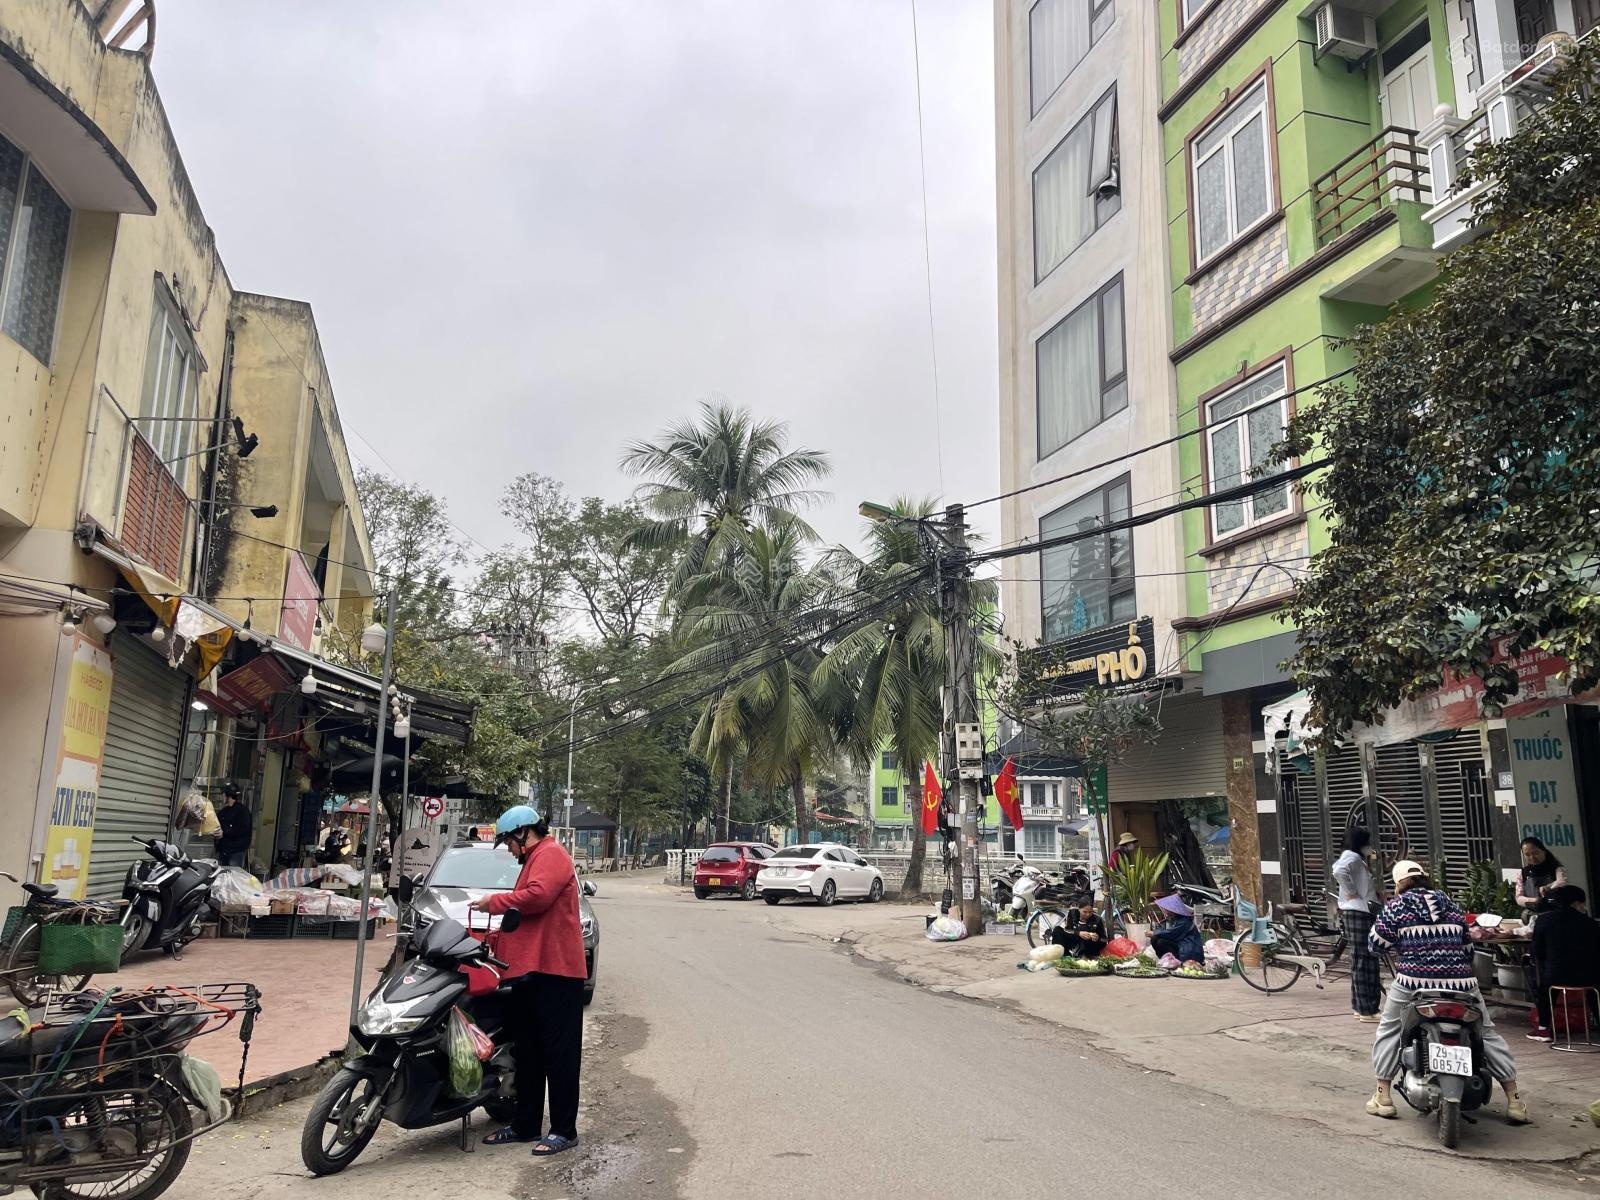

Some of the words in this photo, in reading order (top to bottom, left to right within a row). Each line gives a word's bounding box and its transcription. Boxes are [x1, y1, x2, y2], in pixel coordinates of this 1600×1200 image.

[1097, 623, 1147, 685] PHỐ
[1513, 730, 1563, 761] THUỐC
[51, 787, 75, 826] ATM
[73, 789, 96, 828] BEER
[1528, 781, 1558, 808] ĐẠT
[1433, 1058, 1469, 1073] 085.76
